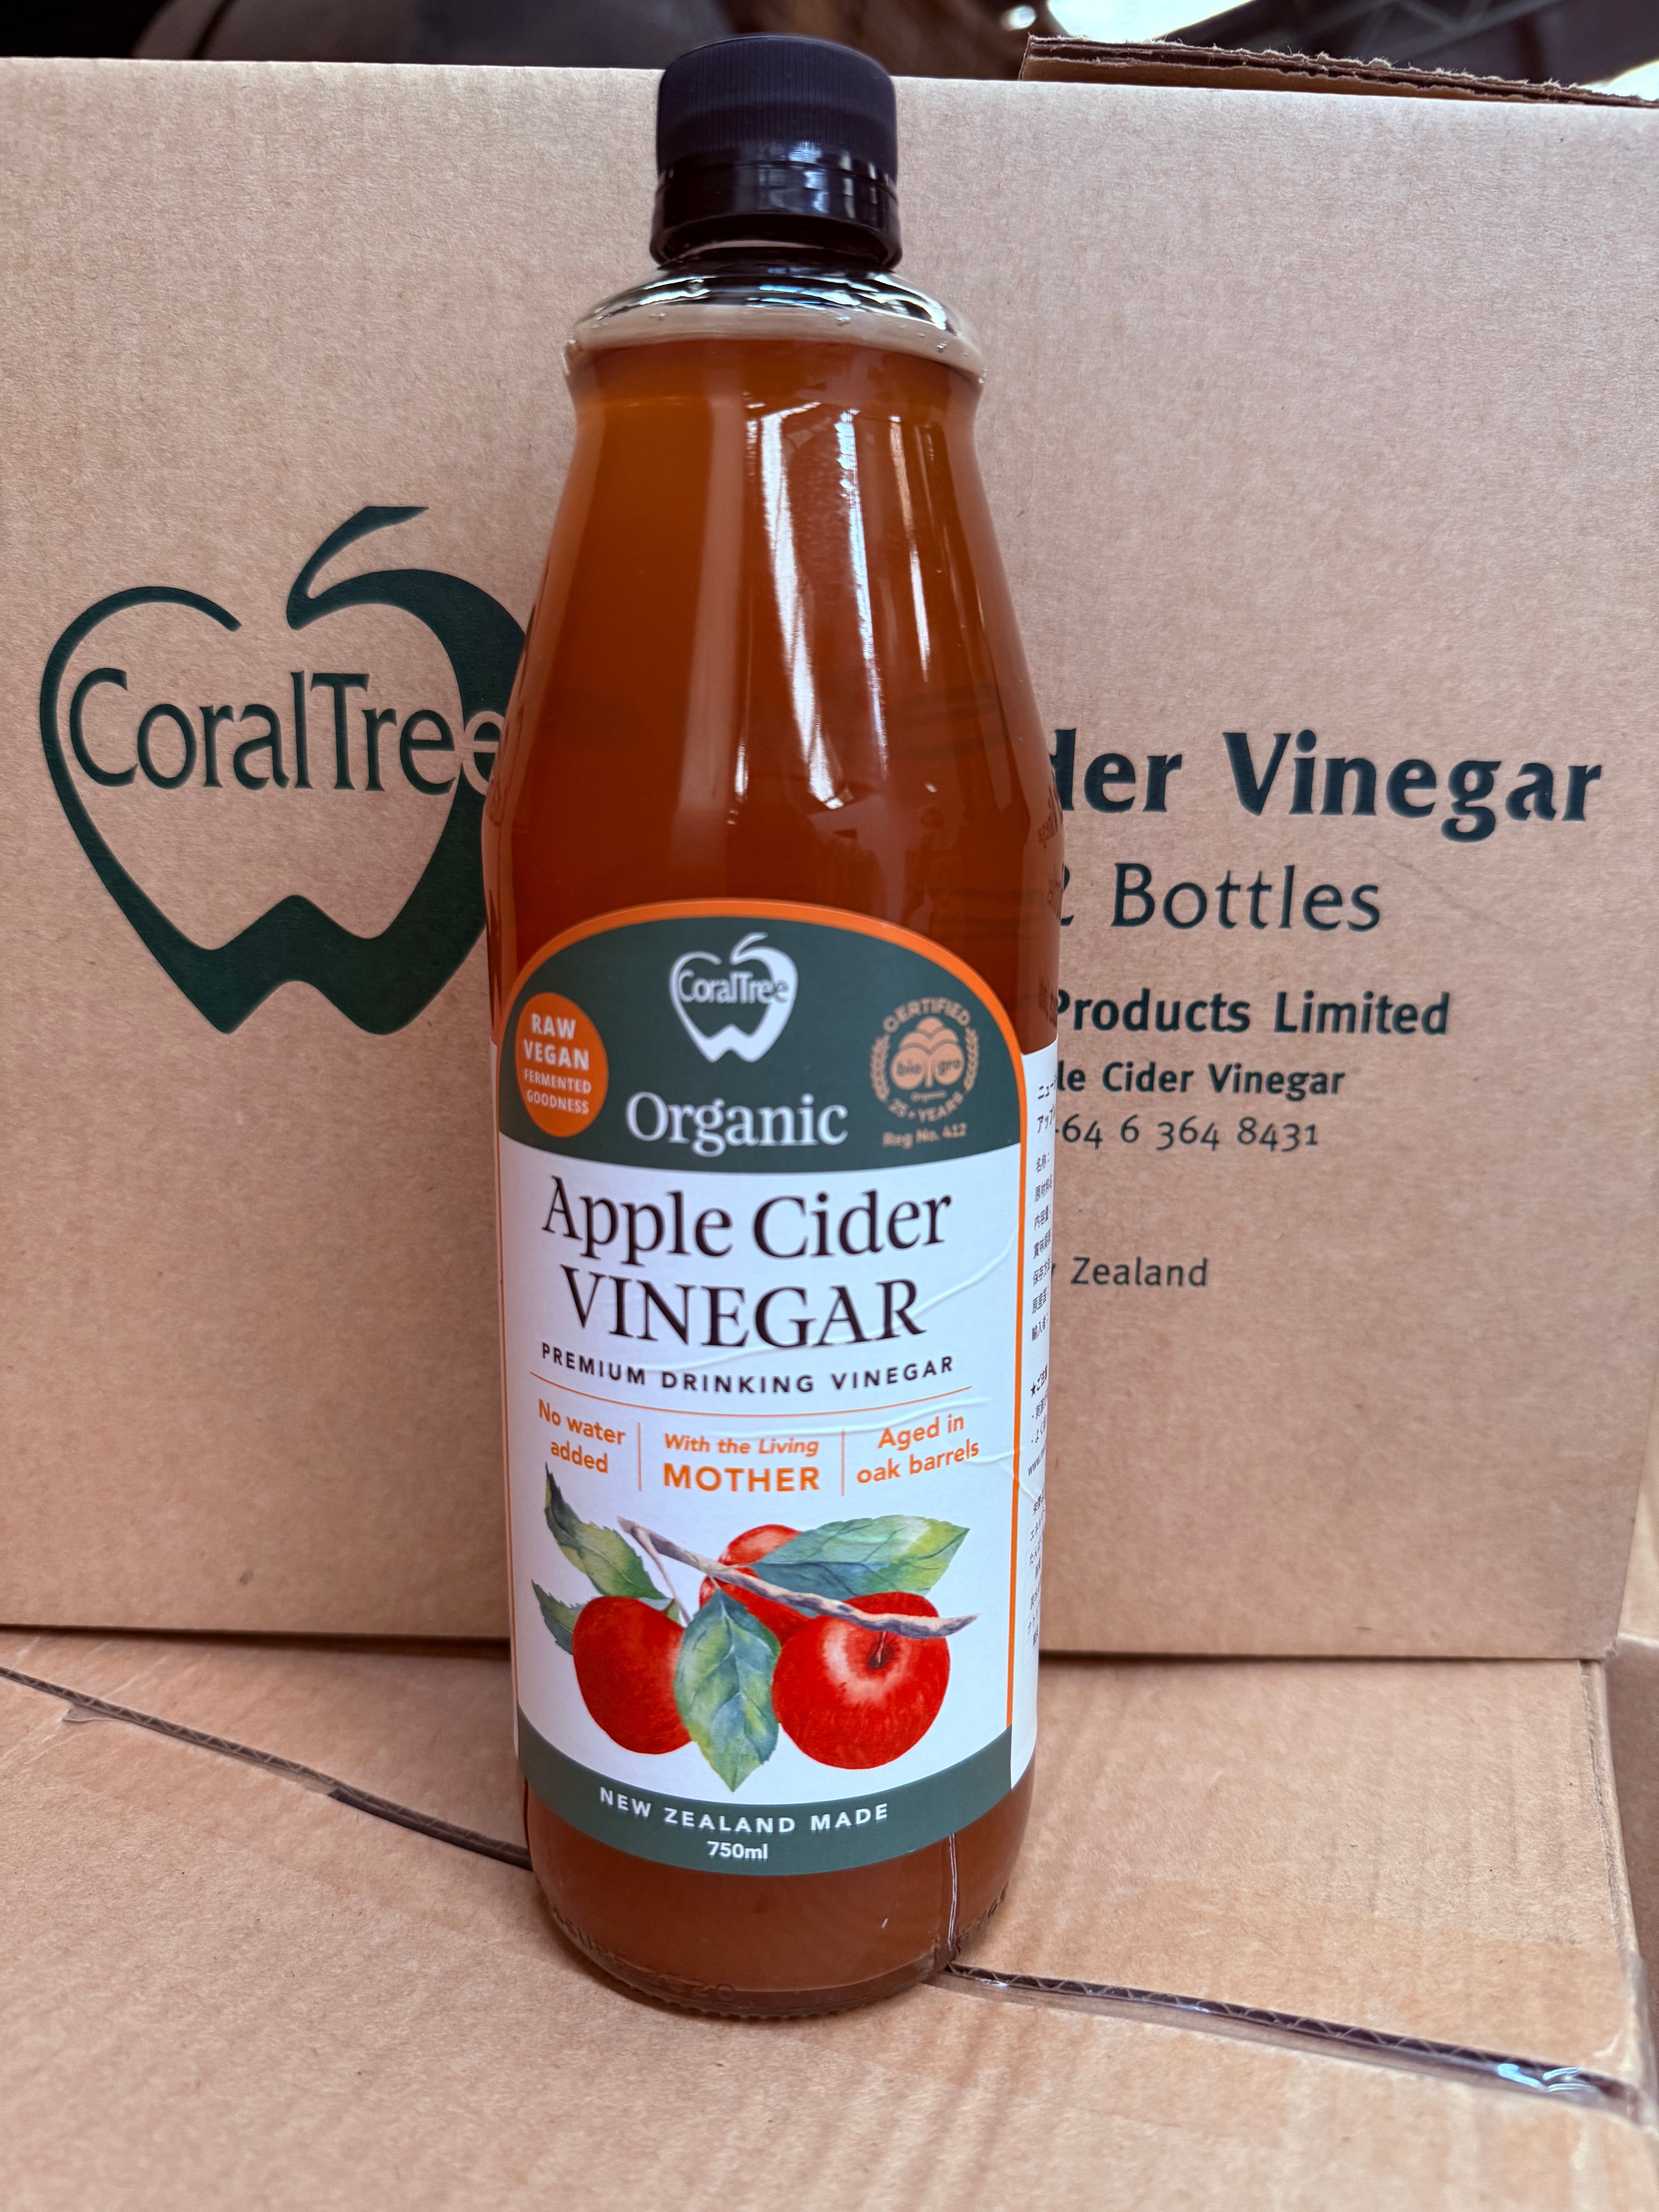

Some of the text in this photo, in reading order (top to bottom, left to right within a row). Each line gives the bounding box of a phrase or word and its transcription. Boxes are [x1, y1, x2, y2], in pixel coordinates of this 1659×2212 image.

[70, 667, 505, 796] CoralTree
[1049, 728, 1602, 842] der Vinegar
[1110, 863, 1379, 931] Bottles
[678, 968, 791, 1003] CoralTree
[531, 1013, 576, 1040] RAW
[882, 997, 971, 1033] CERTIFIED
[1274, 991, 1450, 1036] Limited
[523, 1039, 590, 1071] VEGAN
[524, 1068, 592, 1094] FERMENTED
[1102, 1062, 1194, 1093] Cider
[1208, 1063, 1345, 1101] Vinegar
[527, 1089, 590, 1115] GOODNESS
[626, 1091, 849, 1157] Organic
[882, 1132, 913, 1149] Reg
[942, 1122, 967, 1138] 412
[1055, 1113, 1318, 1152] 64 6 364 8431
[542, 1175, 952, 1267] Apple Cider
[1071, 1256, 1207, 1287] Zealand
[560, 1265, 927, 1349] VINEGAR
[542, 1342, 953, 1394] PREMIUM DRINKING VINEGAR
[539, 1398, 626, 1445] No water
[877, 1414, 964, 1451] Aged in
[550, 1440, 608, 1474] added
[664, 1433, 819, 1457] With the Living
[856, 1438, 979, 1484] oak barrels
[663, 1462, 820, 1493] MOTHER
[600, 1786, 888, 1834] NEW ZEALAND MADE
[706, 1840, 769, 1861] 750ml
